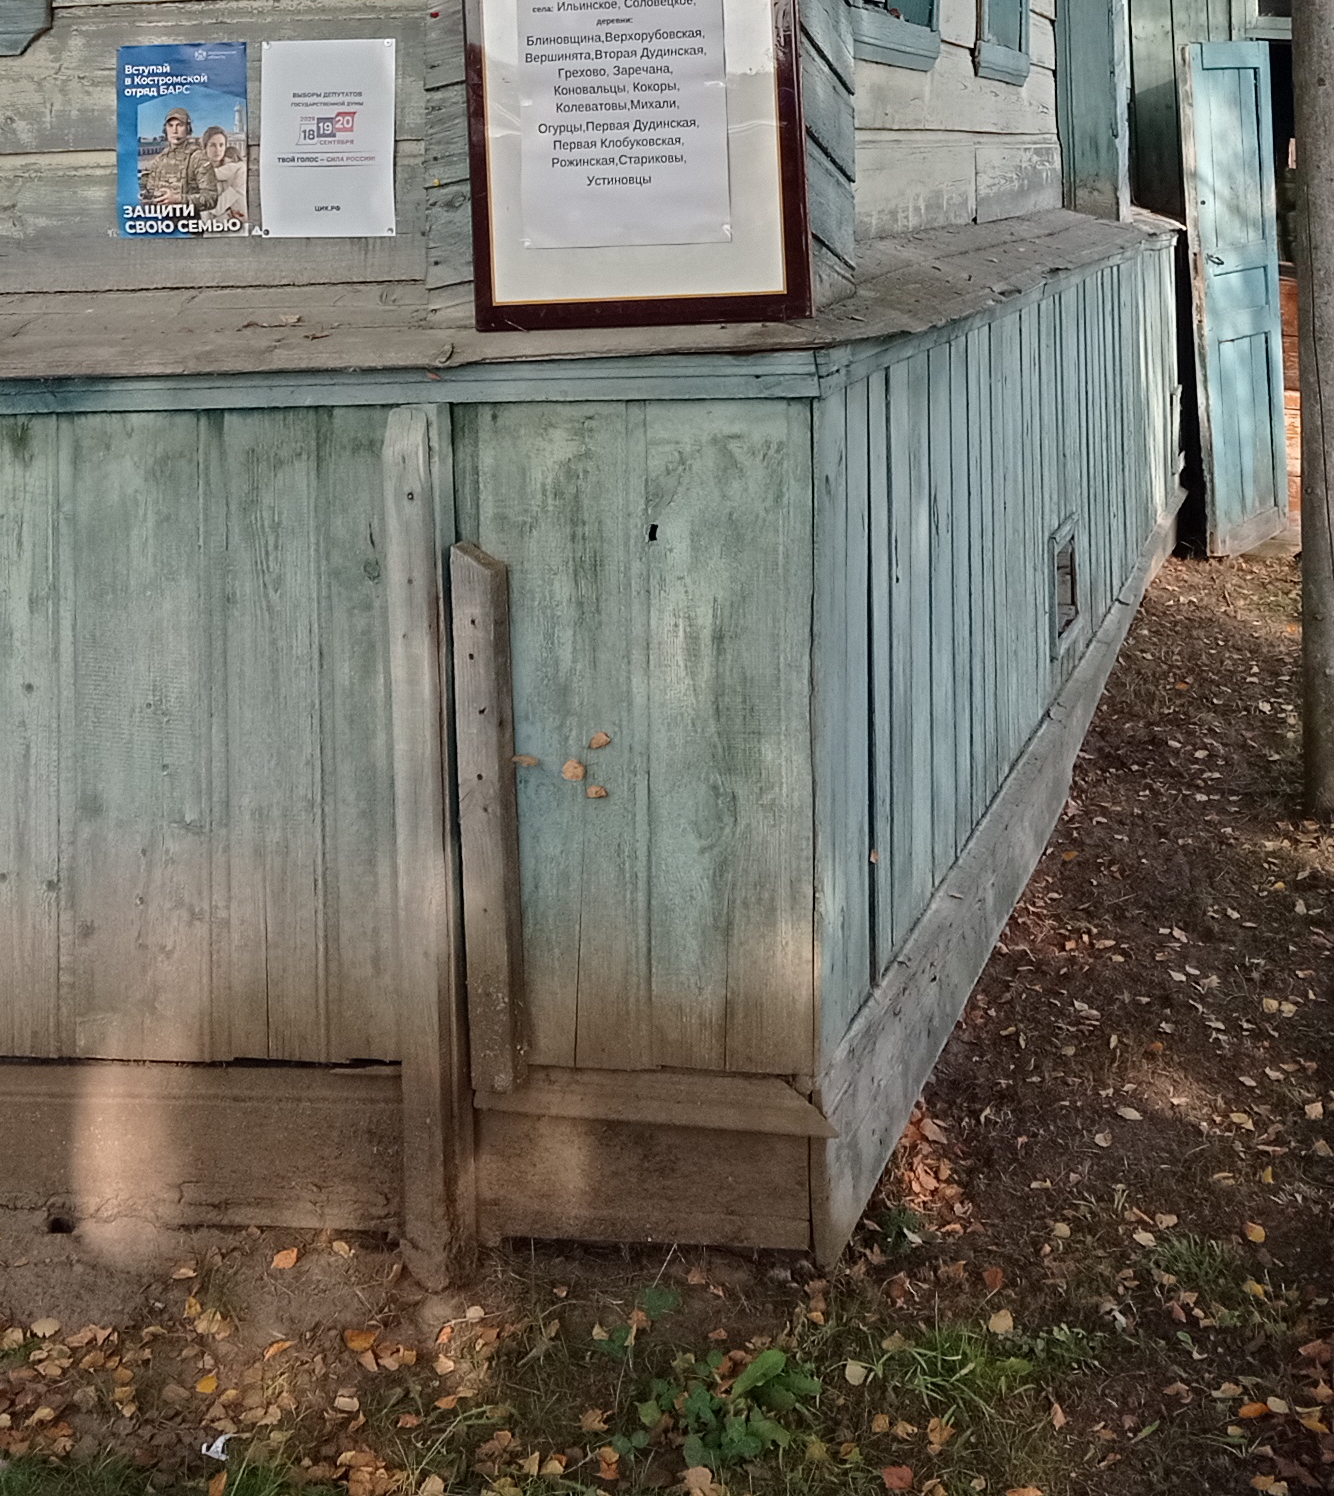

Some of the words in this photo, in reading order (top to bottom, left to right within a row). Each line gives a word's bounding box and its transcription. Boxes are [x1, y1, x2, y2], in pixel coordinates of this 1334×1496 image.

[531, 4, 554, 13] села:
[556, 0, 621, 12] Ильинское,
[595, 16, 634, 27] деревни:
[639, 45, 707, 61] Дудинская,
[124, 62, 171, 76] Вступай
[557, 67, 610, 81] Грехово,
[612, 63, 674, 79] Заречана,
[125, 77, 132, 85] в
[133, 73, 208, 87] Костромской
[124, 88, 158, 98] отряд
[159, 84, 191, 95] БАРС
[553, 84, 630, 97] Коновальцы,
[632, 81, 681, 94] Кокоры,
[301, 129, 316, 141] 18
[318, 122, 333, 134] 19
[334, 116, 353, 128] 20
[632, 118, 700, 133] Дудинская,
[552, 138, 597, 153] Первая
[599, 135, 685, 151] Клобуковская,
[586, 174, 652, 187] Устиновцы
[123, 203, 195, 220] ЗАЩИТИ
[124, 220, 175, 234] СВОЮ
[177, 218, 242, 233] СЕМЬЮ
